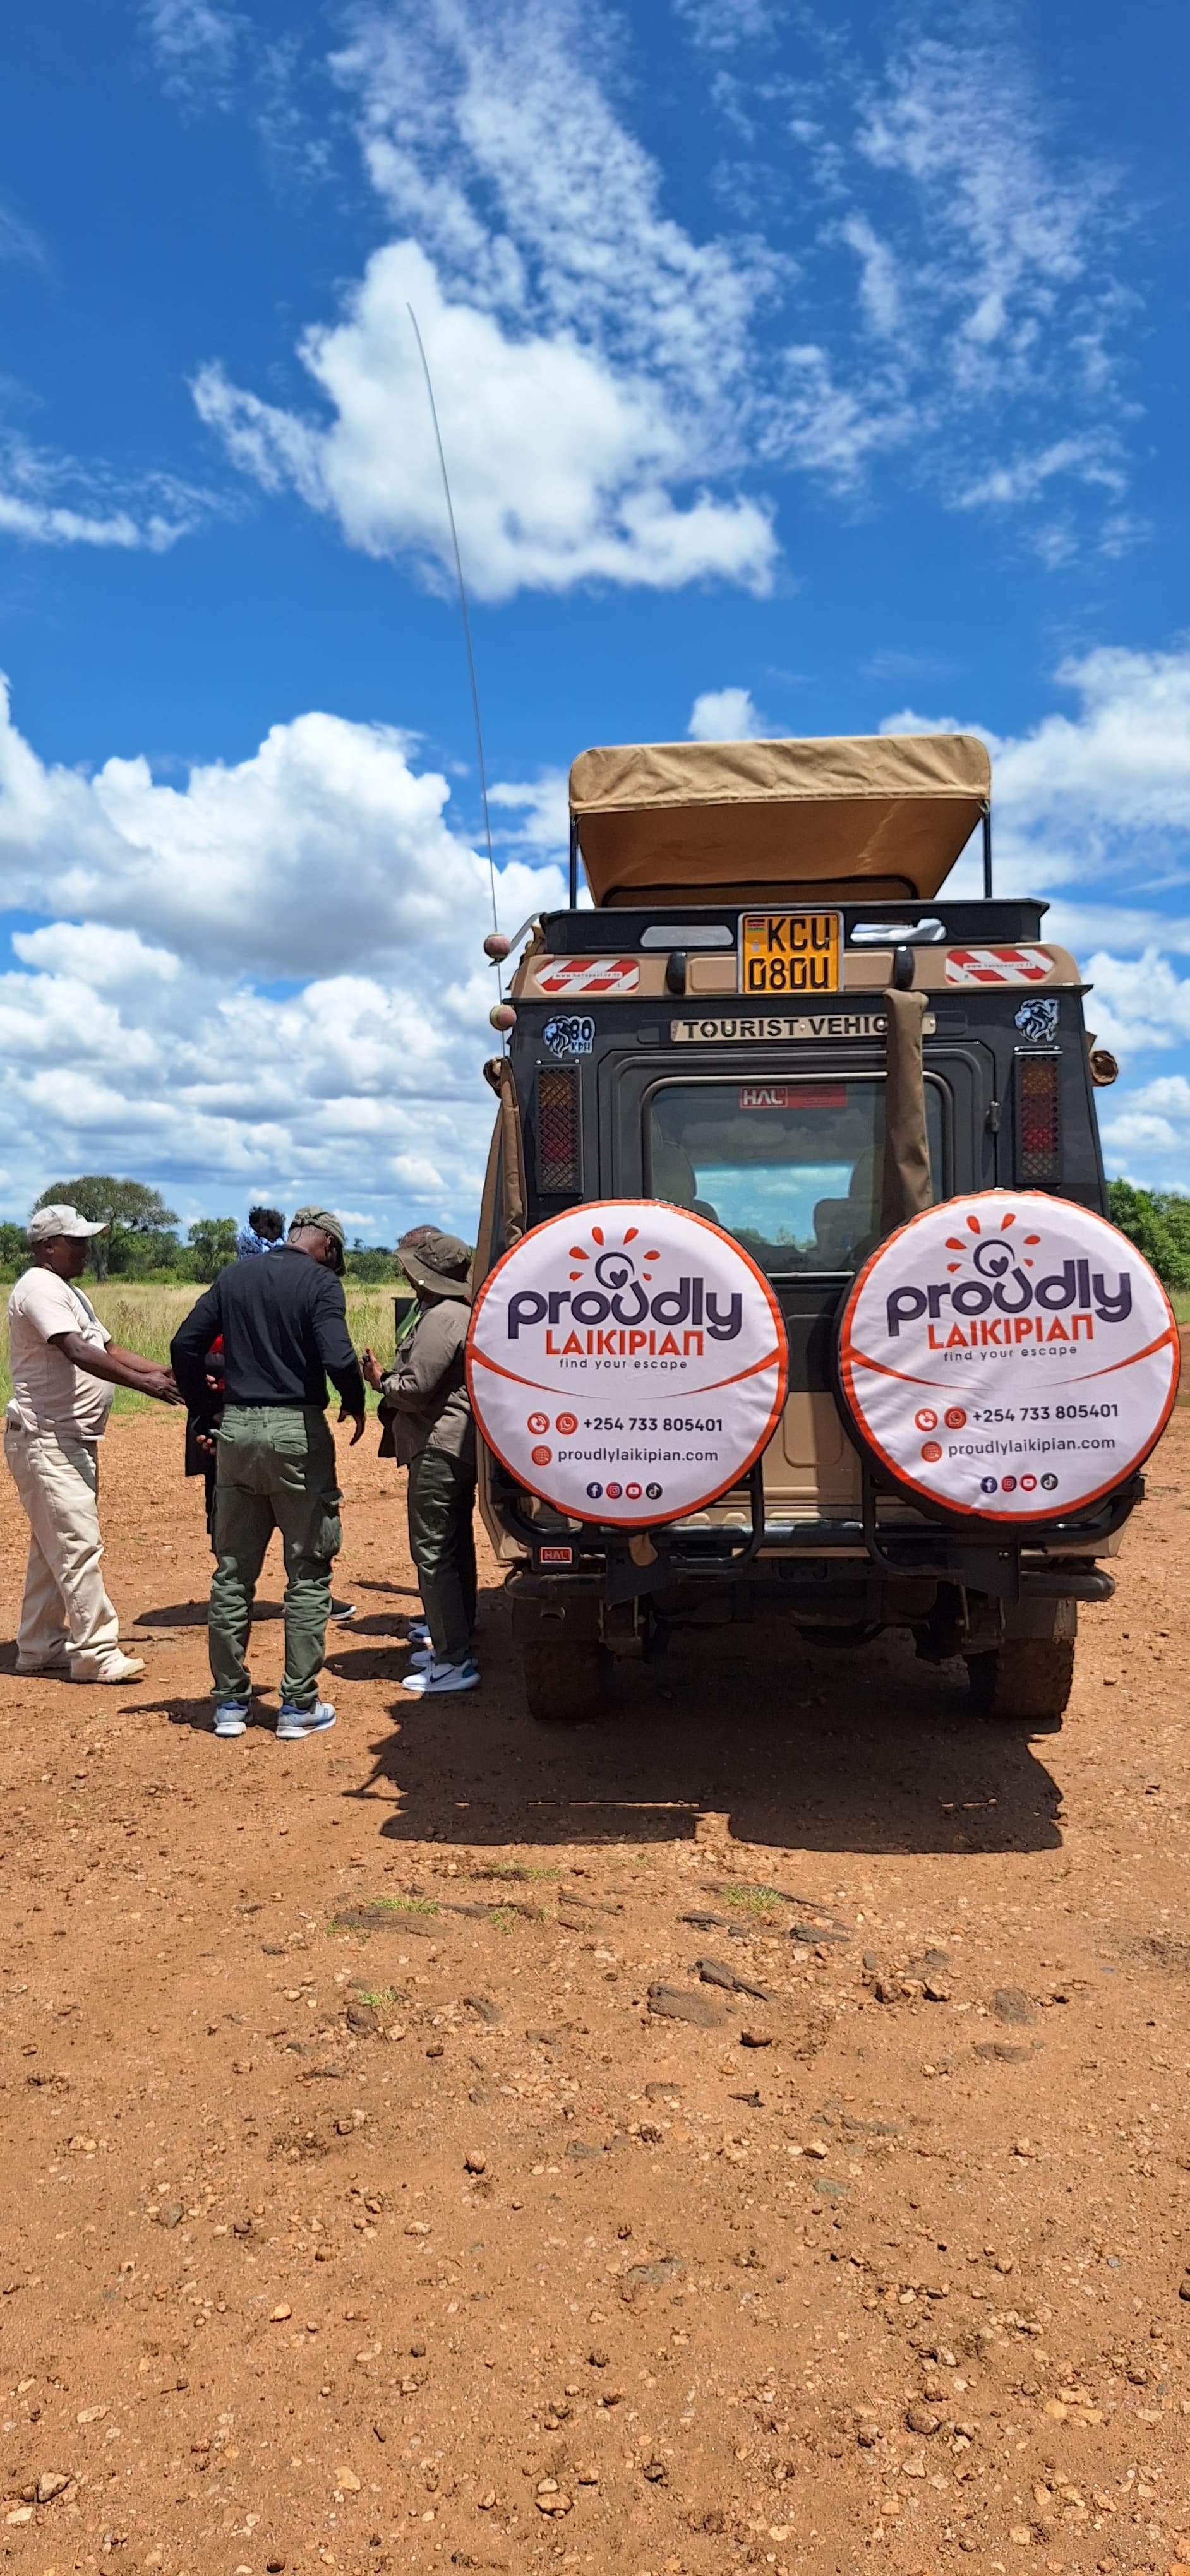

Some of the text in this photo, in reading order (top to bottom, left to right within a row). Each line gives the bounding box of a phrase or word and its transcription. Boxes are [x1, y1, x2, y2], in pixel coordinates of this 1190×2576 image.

[767, 917, 830, 952] KCU
[749, 957, 829, 990] 080U
[570, 1019, 592, 1041] 80
[683, 1016, 888, 1039] TOURIST VEHIC
[571, 1042, 591, 1051] KPH
[743, 1090, 784, 1105] HAL
[886, 1259, 1133, 1337] proudly
[508, 1277, 742, 1341] proudly
[927, 1313, 1093, 1349] LAIKIPIAN
[546, 1329, 704, 1356] LAIKIPIAN
[944, 1345, 1078, 1361] find your escape
[560, 1358, 688, 1370] find your escape
[973, 1404, 1119, 1422] +254 733 805401
[584, 1417, 723, 1431] +254 733 805401
[558, 1448, 718, 1464] proudlylaikipian.com
[948, 1437, 1115, 1458] proudlylaikipian.com
